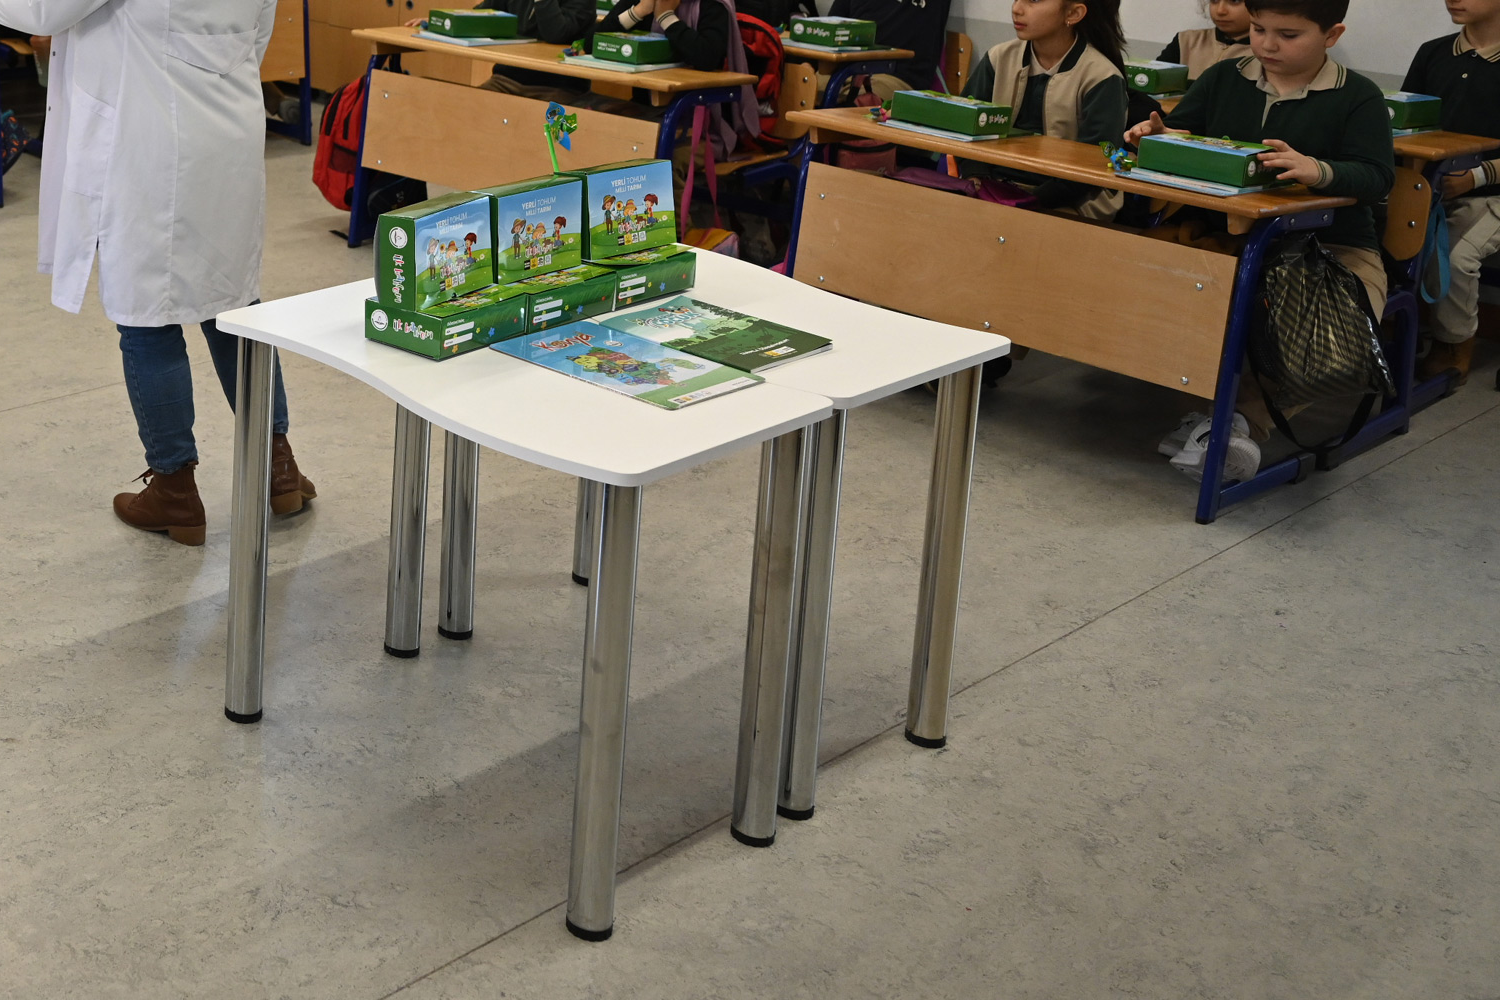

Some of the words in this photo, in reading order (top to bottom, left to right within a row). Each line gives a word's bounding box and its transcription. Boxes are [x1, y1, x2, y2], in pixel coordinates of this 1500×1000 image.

[611, 177, 626, 187] YERLİ
[626, 174, 647, 185] TOHUM
[627, 183, 642, 192] TARIM
[522, 199, 537, 210] YERLİ
[537, 196, 557, 206] TOHUM
[537, 205, 552, 214] TARIM
[529, 331, 596, 353] Konya
